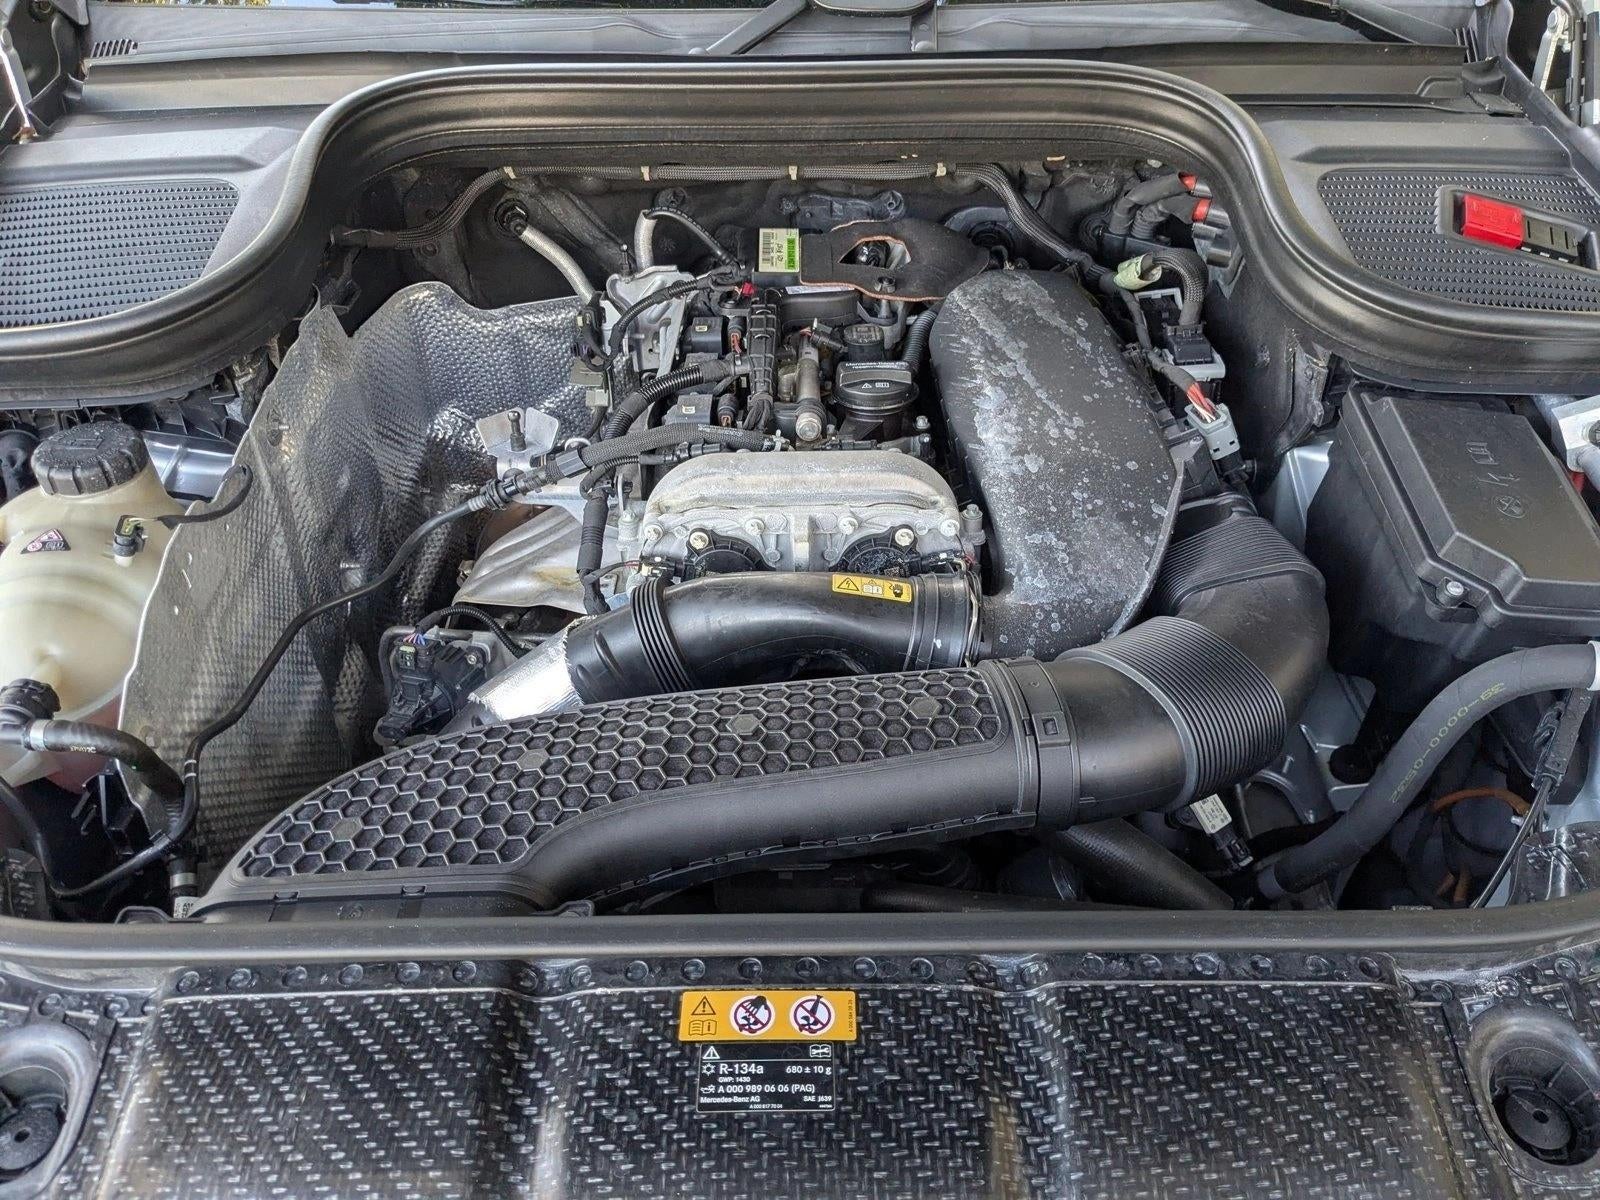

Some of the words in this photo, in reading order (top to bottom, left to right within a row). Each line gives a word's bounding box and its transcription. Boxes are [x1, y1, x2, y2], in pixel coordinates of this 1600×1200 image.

[719, 1063, 764, 1075] R-134a
[786, 1065, 803, 1074] 680
[813, 1065, 824, 1074] 10
[825, 1066, 832, 1076] g
[718, 1085, 725, 1093] A
[726, 1084, 744, 1093] 000
[745, 1084, 762, 1093] 989
[764, 1084, 776, 1093] 06
[777, 1084, 790, 1093] 06
[791, 1083, 816, 1094] (PAG)
[700, 1095, 749, 1104] Mercedes-Benz
[750, 1095, 761, 1103] AG
[817, 1095, 832, 1103] J639
